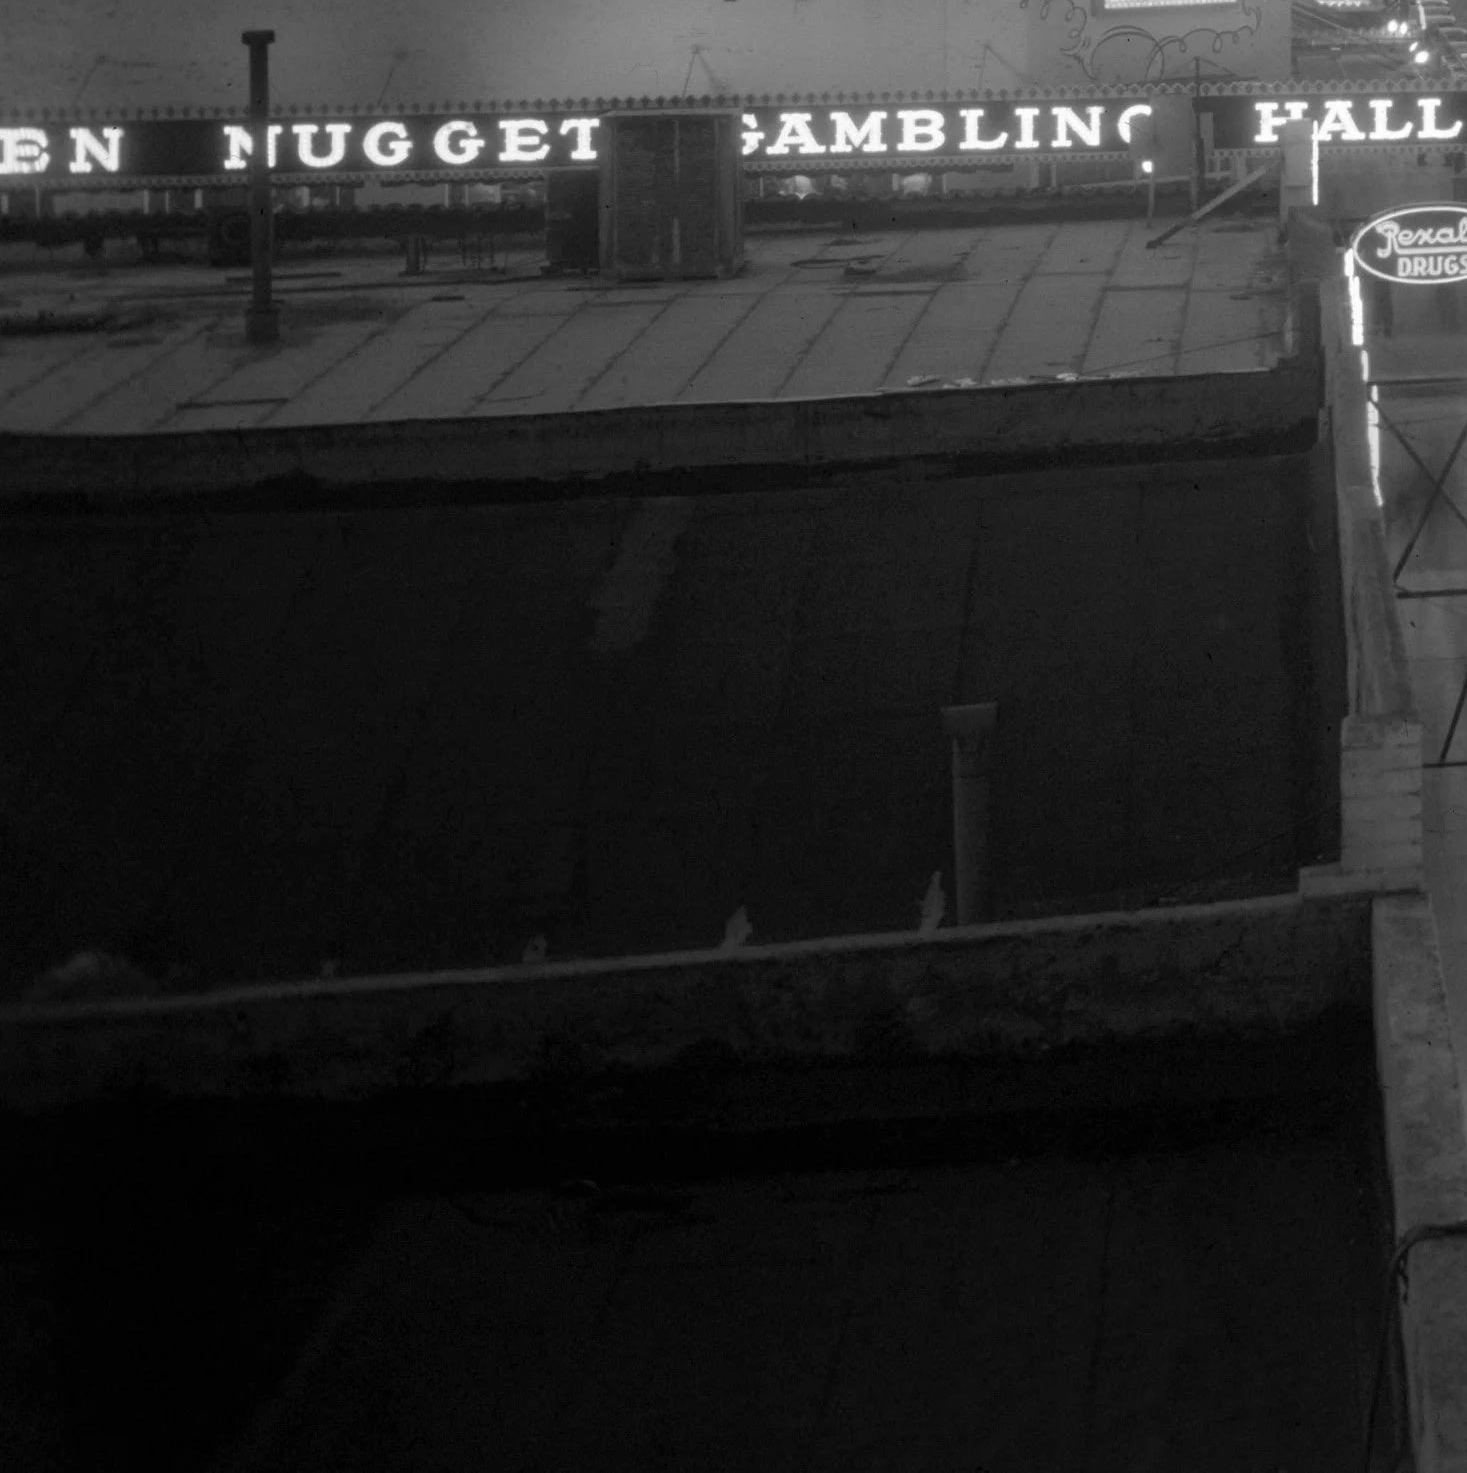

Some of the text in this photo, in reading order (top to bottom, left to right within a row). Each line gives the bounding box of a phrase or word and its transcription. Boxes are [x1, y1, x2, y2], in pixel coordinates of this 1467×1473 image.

[223, 119, 600, 170] NUGGET
[1255, 99, 1463, 143] HALL
[0, 127, 124, 174] EN
